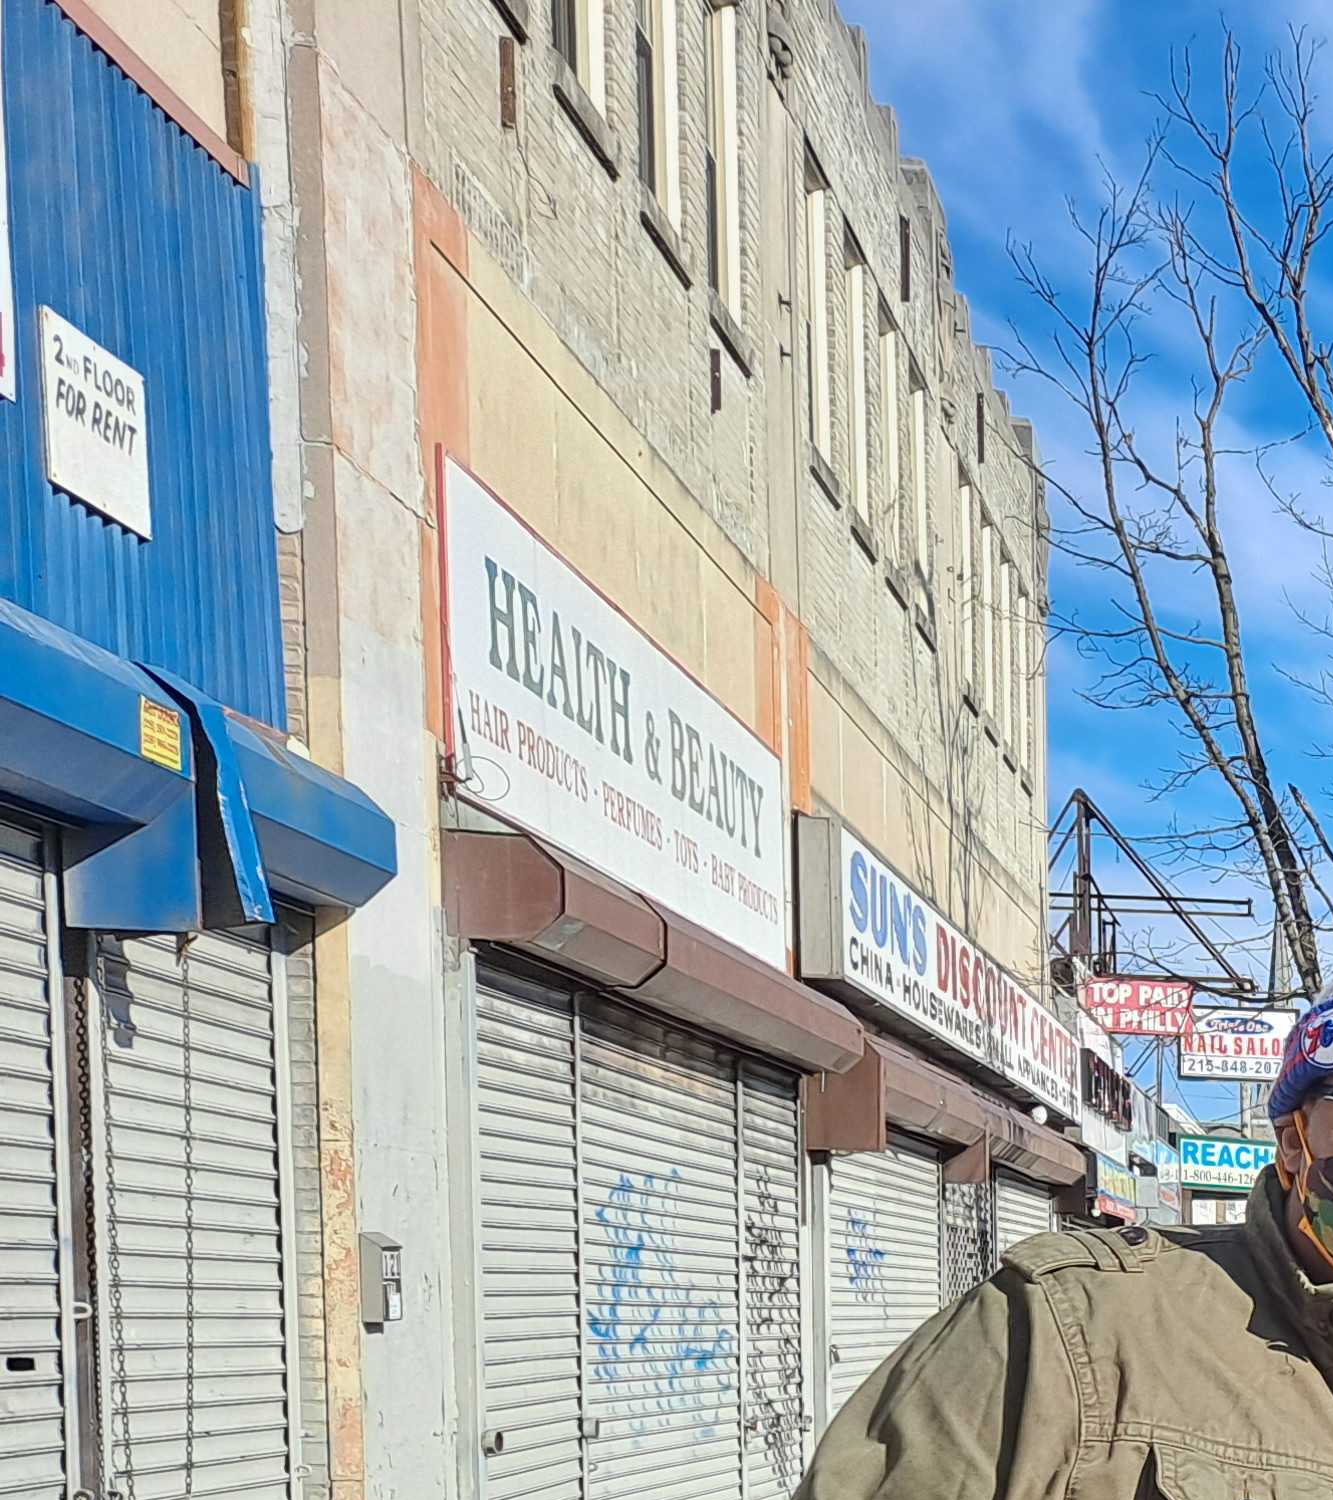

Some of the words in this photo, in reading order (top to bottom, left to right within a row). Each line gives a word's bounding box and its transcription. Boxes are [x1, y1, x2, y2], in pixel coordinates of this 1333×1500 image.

[56, 376, 86, 427] FOR
[91, 401, 137, 456] RENT
[83, 355, 136, 416] FLOOR
[484, 554, 633, 765] HEALTH
[644, 710, 663, 785] &
[668, 707, 764, 858] BEAUTY
[469, 690, 511, 753] HAIR
[516, 719, 588, 802] PRODUCTS
[601, 780, 662, 851] PERFUMES
[673, 829, 699, 874] TOYS
[711, 853, 736, 897] BABY
[737, 871, 778, 925] PRODUCTS
[850, 851, 927, 976] SUN'S
[936, 921, 1027, 1050] DISCOUNT
[1031, 1007, 1079, 1091] CENTER
[850, 936, 894, 993] CHINA
[903, 974, 982, 1050] HOUSEWARES
[1091, 982, 1132, 1005] TOP
[1139, 985, 1188, 1008] PAID
[1120, 1009, 1188, 1033] PHILLY
[1184, 1034, 1227, 1055] NAIL
[1233, 1036, 1282, 1057] SALO
